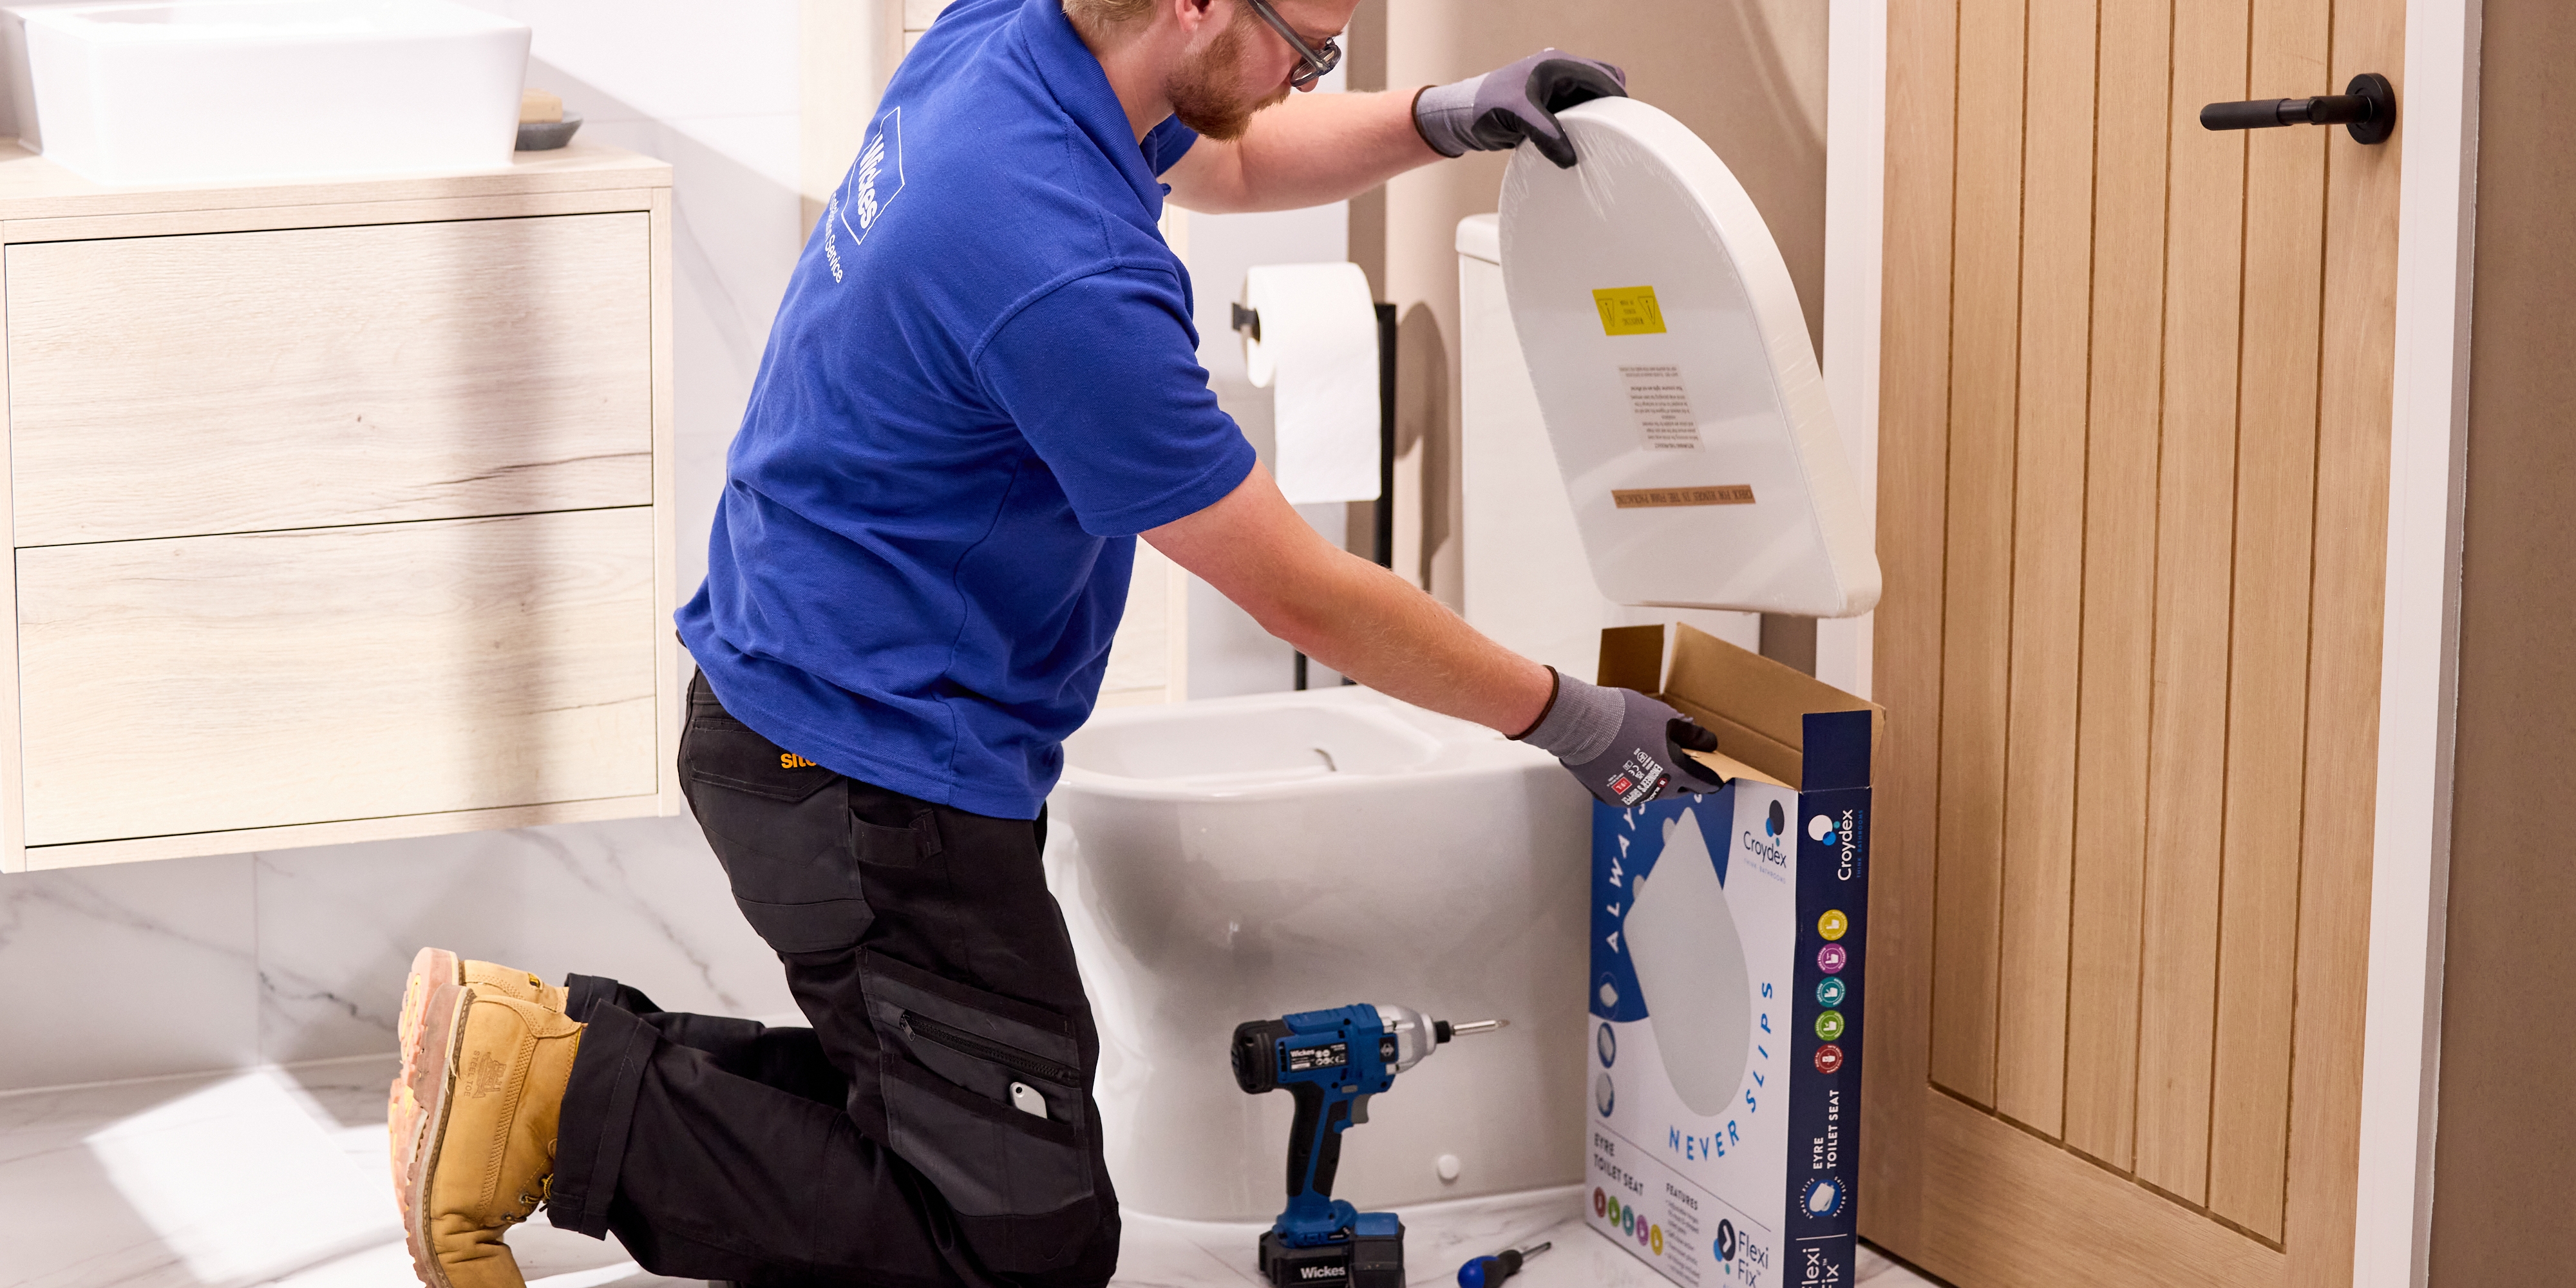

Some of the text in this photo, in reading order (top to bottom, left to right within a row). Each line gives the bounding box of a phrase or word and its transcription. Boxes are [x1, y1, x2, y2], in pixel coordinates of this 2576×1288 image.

[858, 134, 884, 229] Wickes
[825, 192, 843, 283] nstallation Service
[1743, 831, 1786, 868] Croydex
[1837, 809, 1856, 880] Croydex
[1759, 866, 1786, 884] BATHROOMS
[1290, 1049, 1315, 1057] Wickes
[1744, 982, 1774, 1113] SLIPS
[464, 1050, 480, 1097] STEEL TOE
[1593, 1133, 1615, 1157] EYRE
[1669, 1120, 1739, 1161] NEVER
[1826, 1089, 1840, 1170] TOILET SEAT
[1813, 1137, 1824, 1170] EYRE
[1593, 1153, 1644, 1197] TOILET SEAT
[1665, 1182, 1699, 1211] FEATURES
[1799, 1177, 1815, 1219] ALWAYS FITS
[1832, 1175, 1848, 1218] NEVER SLIPS
[1738, 1230, 1769, 1269] Flexi
[1300, 1265, 1346, 1280] Wickes
